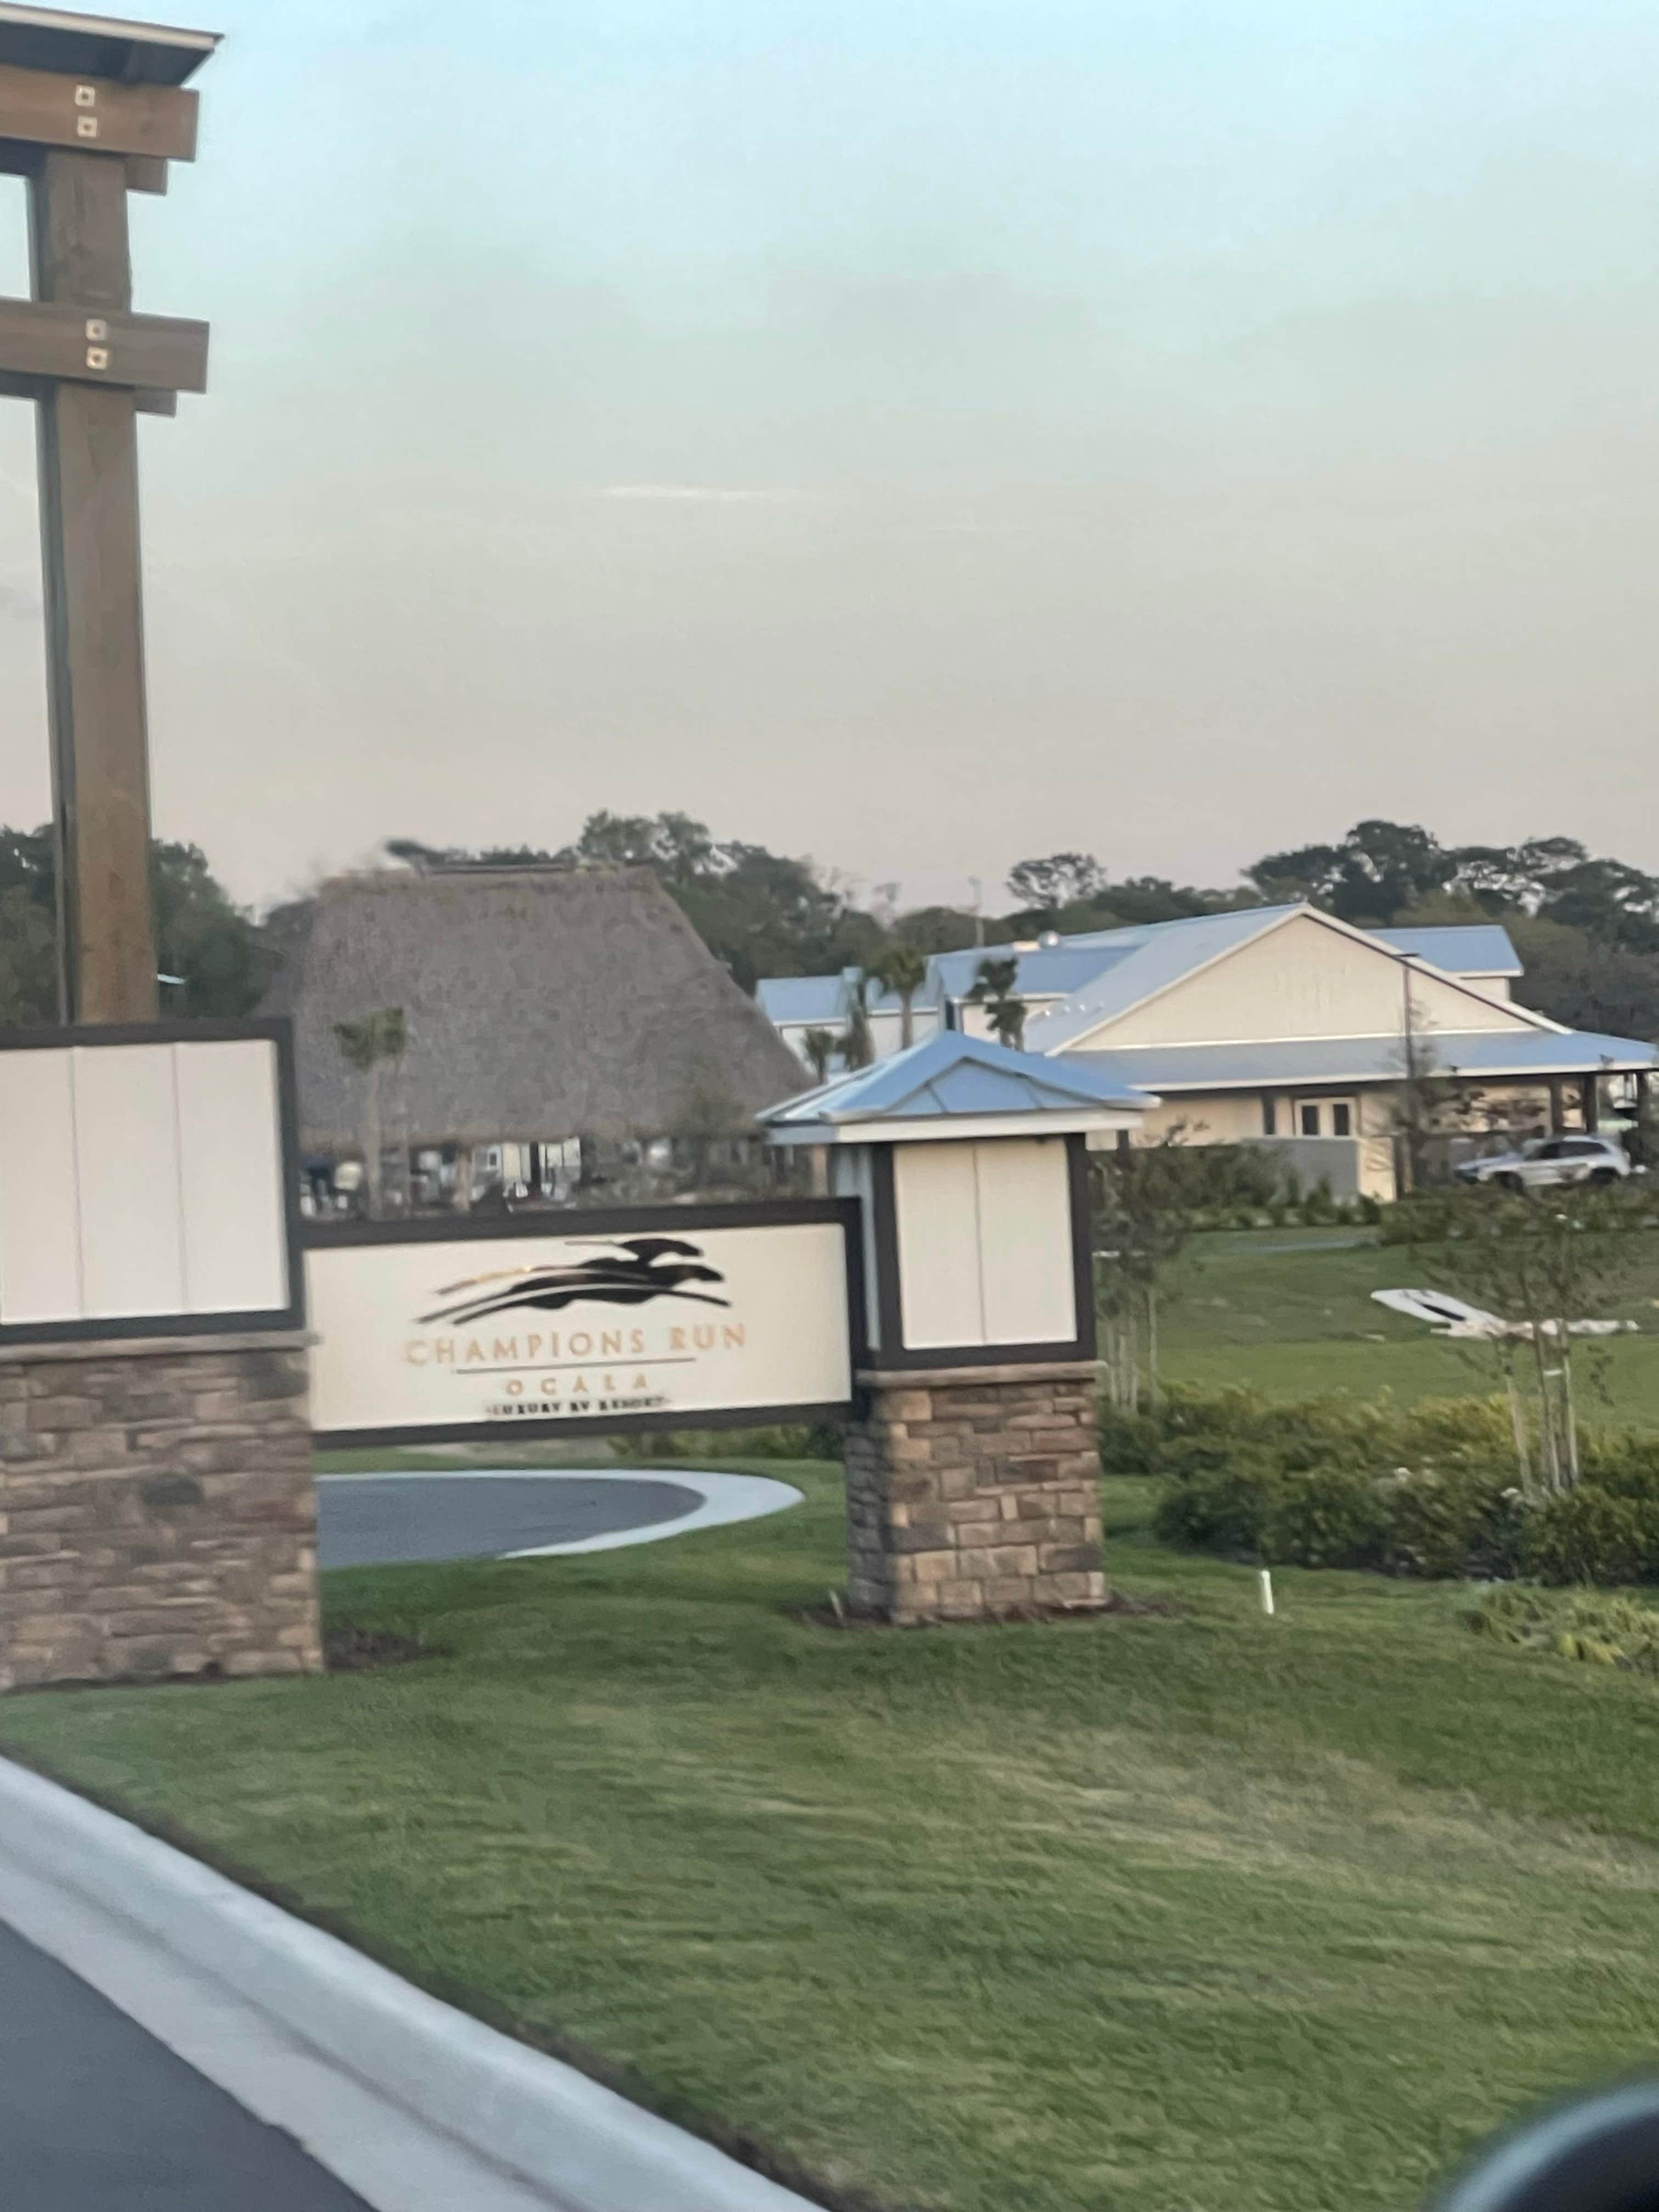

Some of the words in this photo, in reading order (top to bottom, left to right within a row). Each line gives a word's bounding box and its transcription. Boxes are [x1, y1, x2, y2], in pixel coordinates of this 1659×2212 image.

[404, 1329, 645, 1366] CHAMPIONS
[670, 1323, 746, 1350] RUN
[506, 1374, 648, 1396] OCALA
